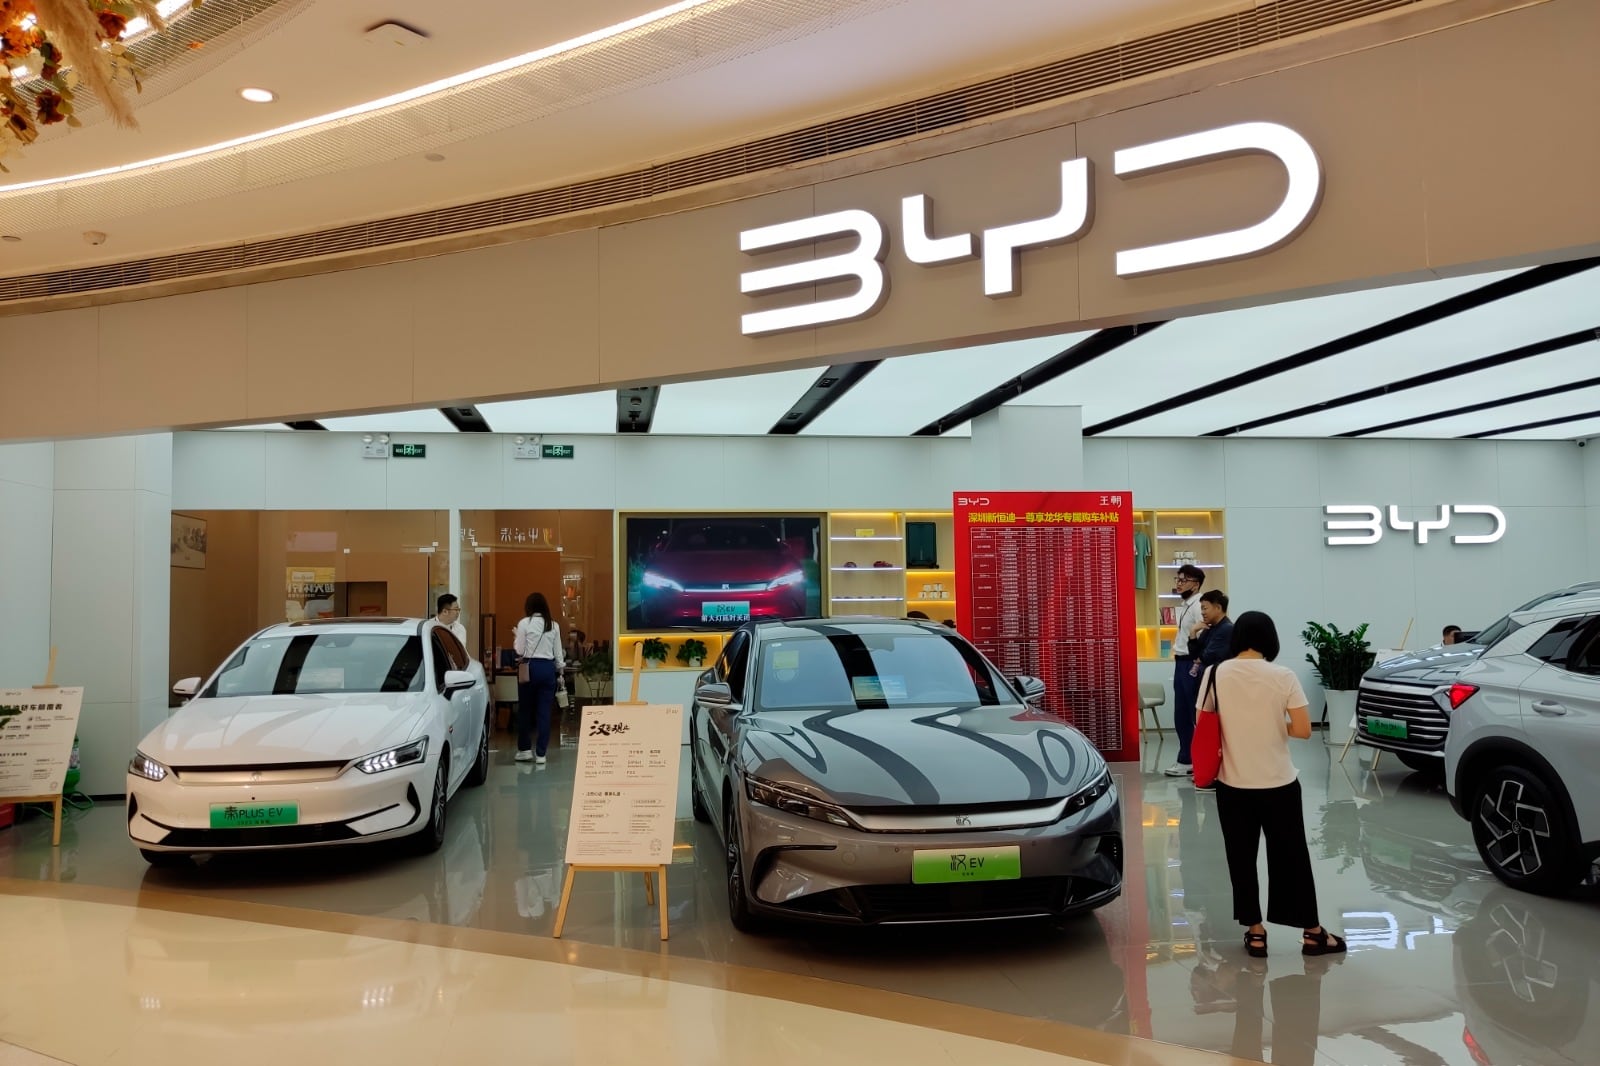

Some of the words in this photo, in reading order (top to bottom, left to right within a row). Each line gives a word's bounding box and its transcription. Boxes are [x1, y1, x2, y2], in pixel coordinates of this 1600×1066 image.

[739, 120, 1324, 338] BYD
[957, 497, 990, 506] BYD
[1099, 495, 1122, 508] 王朝
[1323, 504, 1507, 546] BYD
[268, 807, 284, 817] EV
